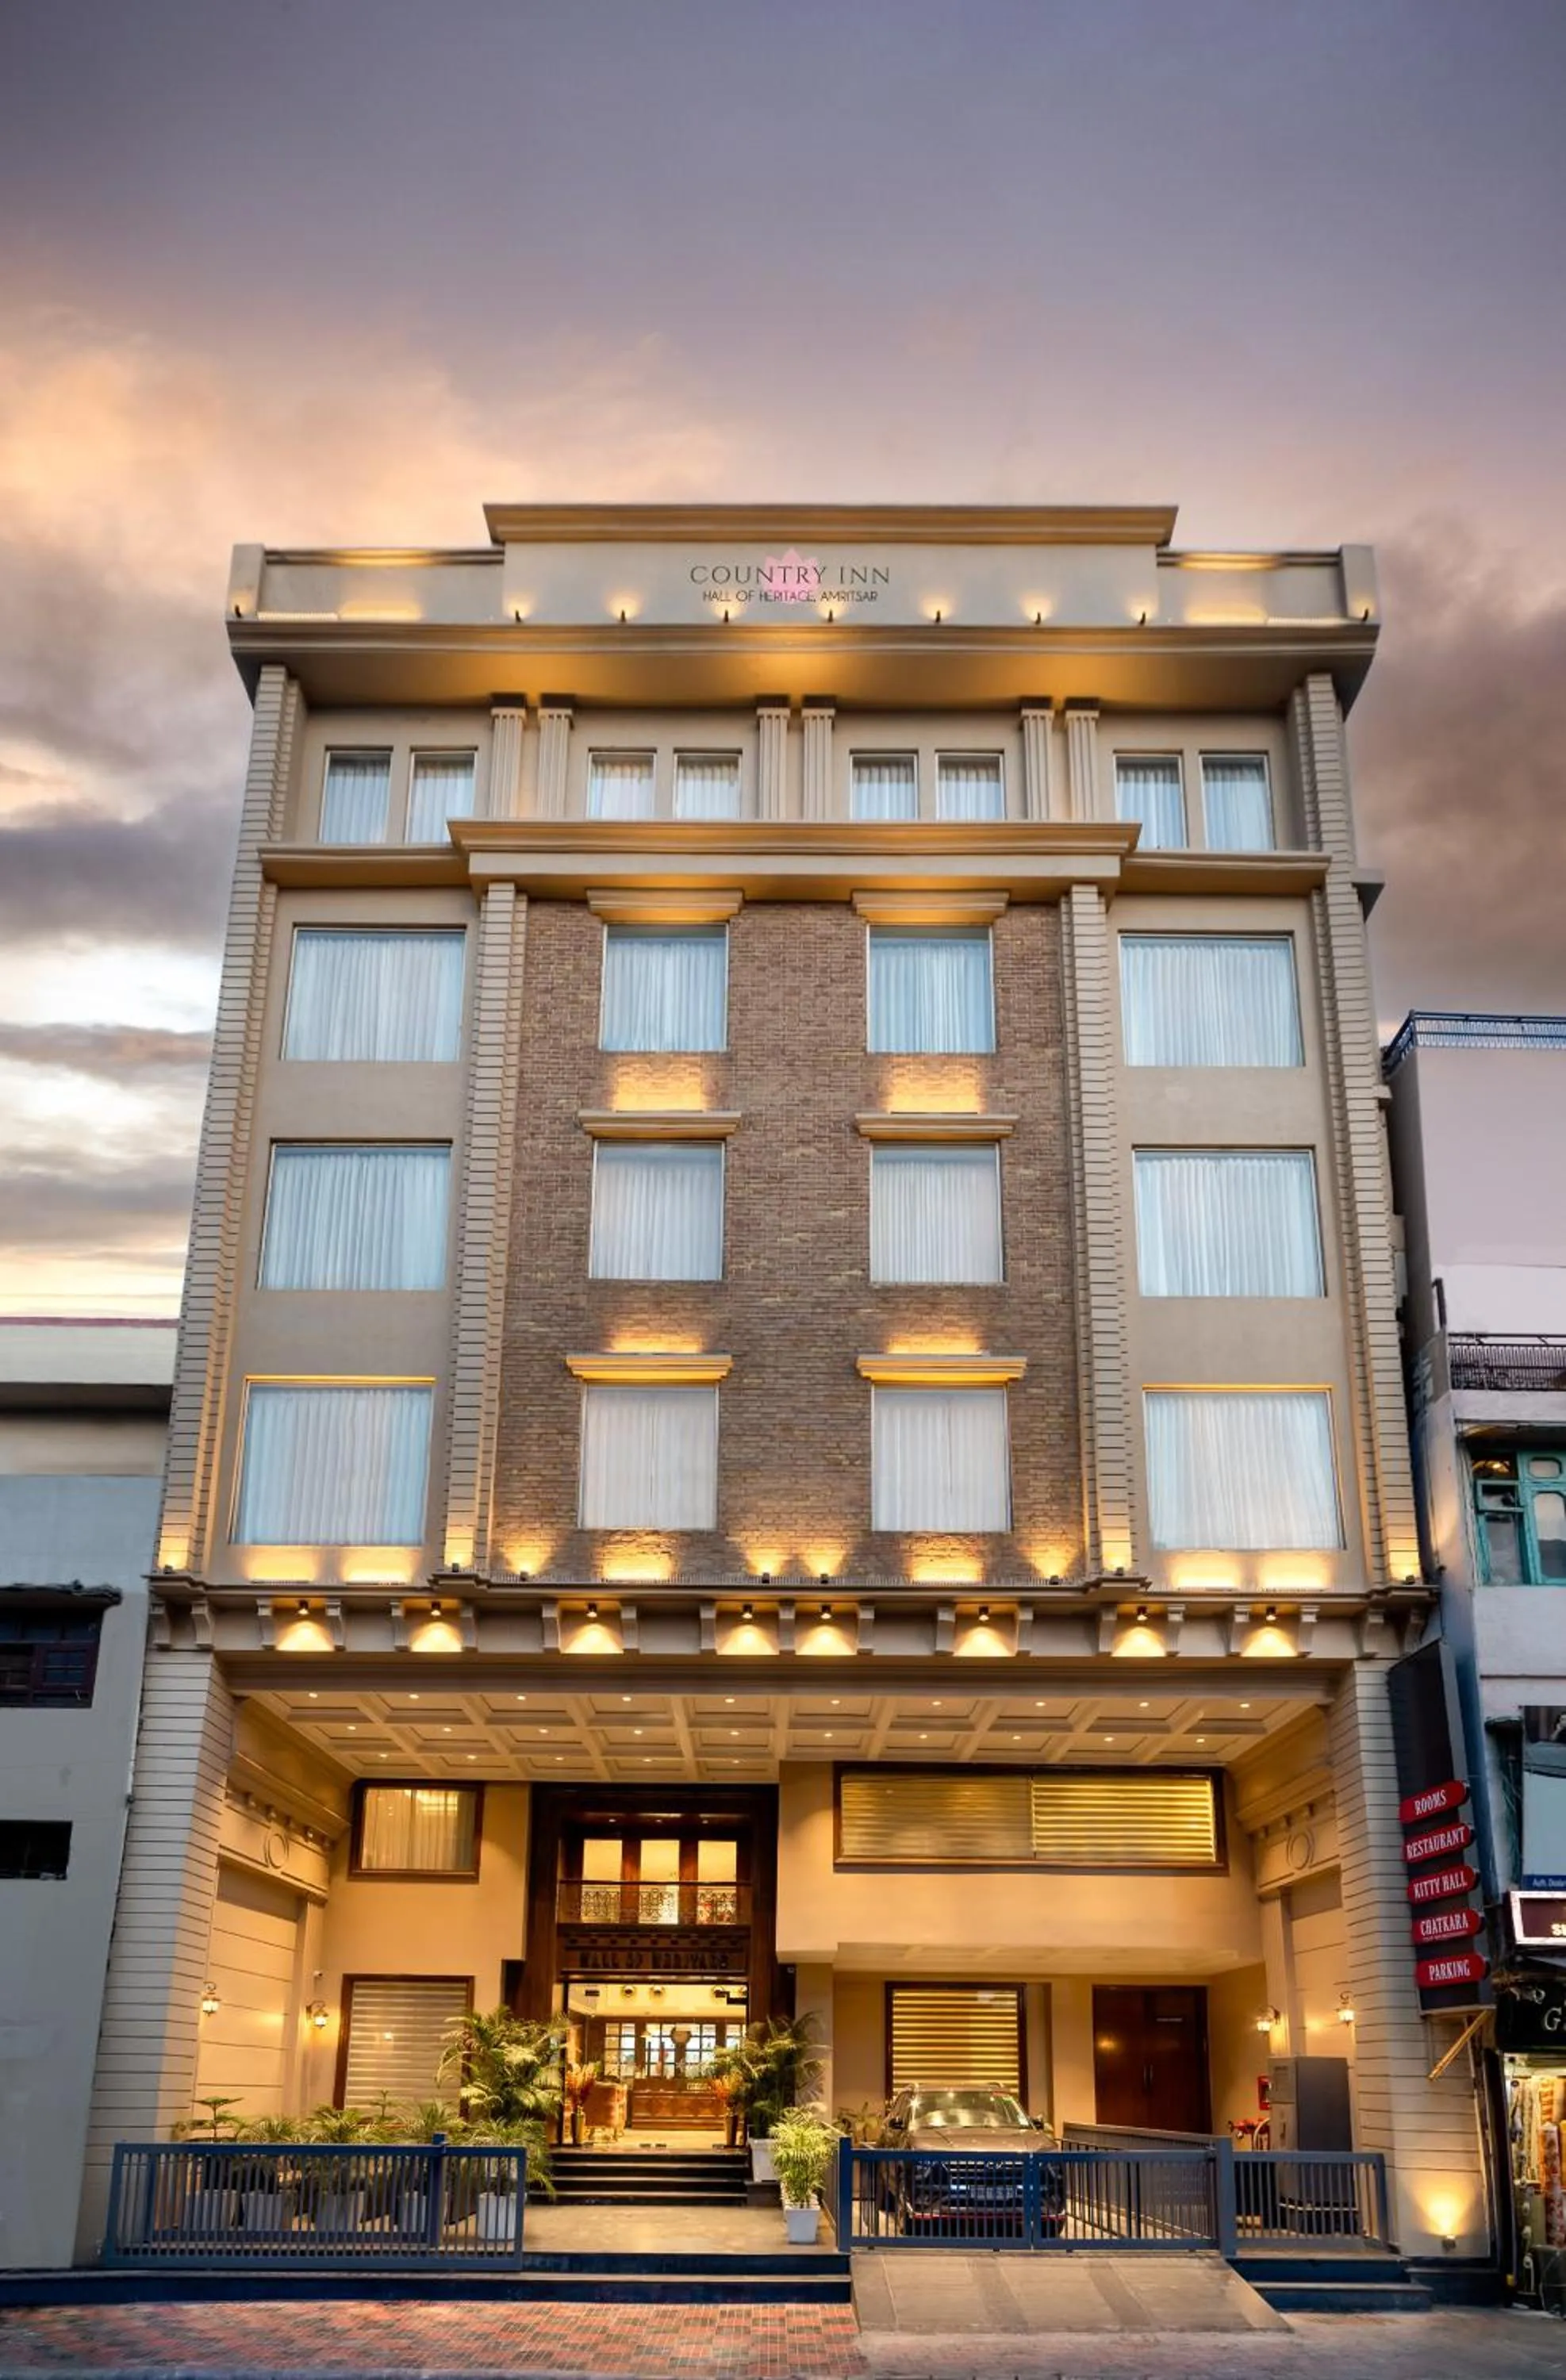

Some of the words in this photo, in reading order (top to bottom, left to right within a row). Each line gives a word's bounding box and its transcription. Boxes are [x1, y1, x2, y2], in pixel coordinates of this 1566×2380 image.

[689, 566, 827, 585] COUNTRY
[839, 566, 890, 585] INN
[703, 589, 731, 603] HALL
[735, 589, 754, 603] OF
[820, 589, 879, 603] AMRITSAR
[1414, 1790, 1447, 1815] ROOMS
[1406, 1826, 1465, 1860] RESTAURANT
[1413, 1876, 1441, 1899] KITTY
[1441, 1871, 1468, 1893] HALL
[1420, 1912, 1469, 1937] CHATKARA
[1429, 1959, 1471, 1981] PARKING
